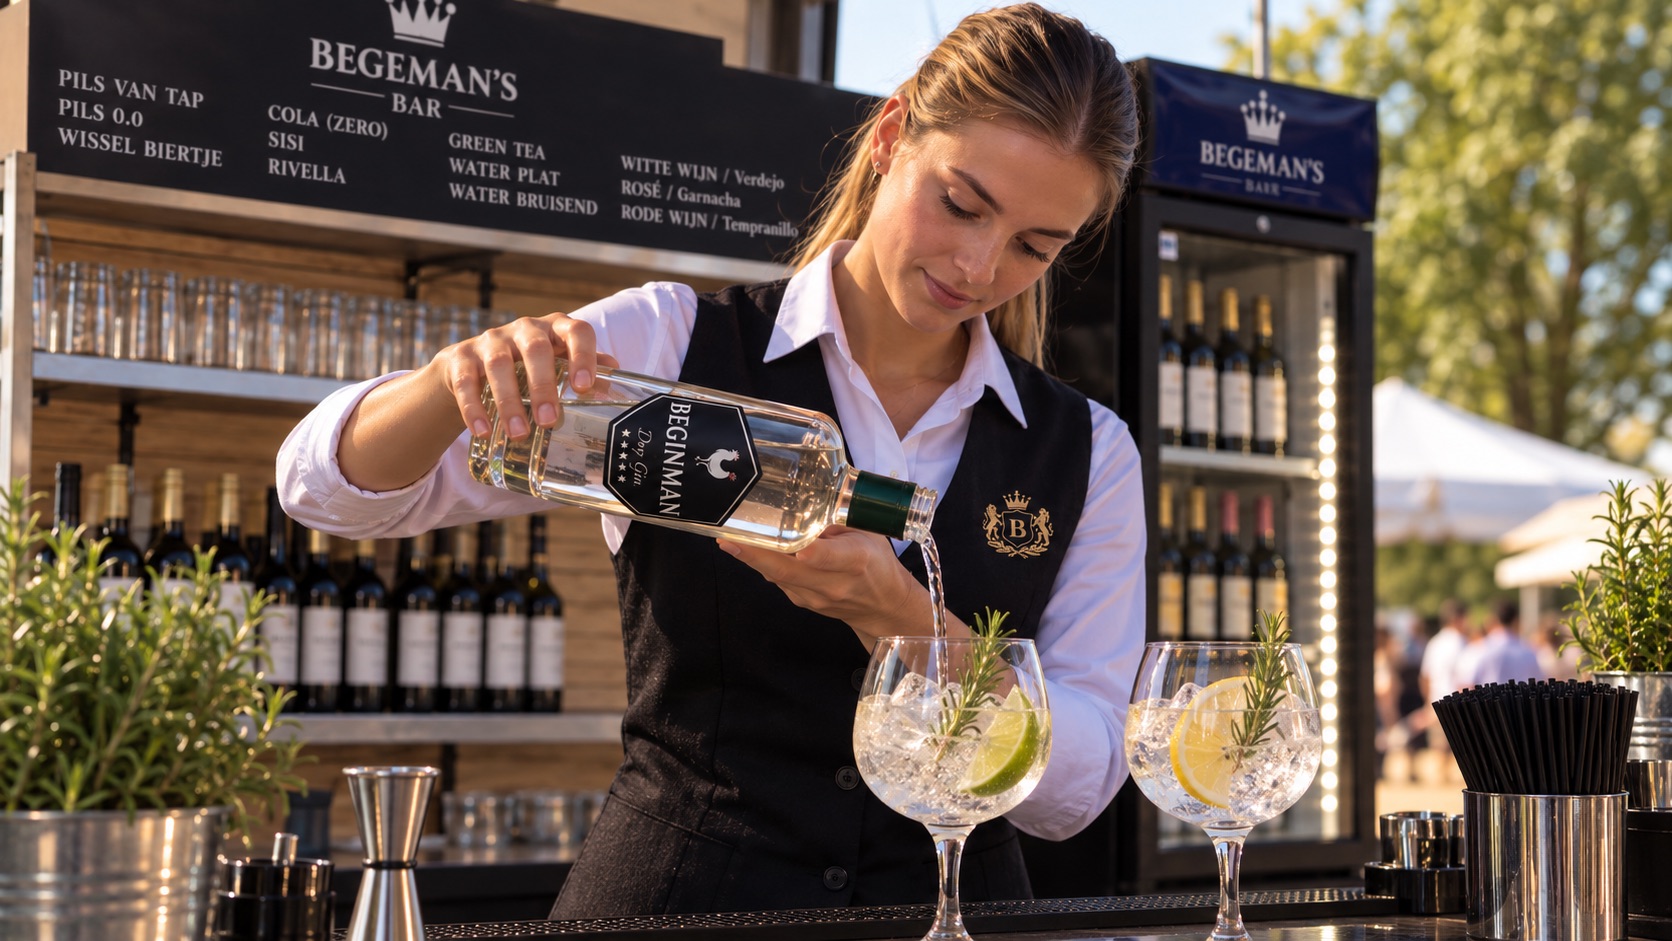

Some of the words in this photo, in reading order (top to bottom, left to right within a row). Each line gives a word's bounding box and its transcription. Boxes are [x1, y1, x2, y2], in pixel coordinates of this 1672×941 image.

[310, 37, 518, 102] BEGEMAN'S
[59, 69, 104, 92] PILS
[114, 79, 156, 101] VAN
[165, 88, 203, 108] TAP
[59, 99, 104, 121] PILS
[113, 108, 143, 127] 0.0
[392, 93, 442, 119] BAR
[268, 105, 318, 127] COLA
[327, 115, 389, 141] (ZERO)
[58, 127, 136, 155] WISSEL
[145, 141, 222, 167] BIERTJE
[269, 132, 303, 151] SISI
[449, 133, 506, 154] GREEN
[513, 142, 545, 160] TEA
[269, 158, 345, 183] RIVELLA
[450, 158, 510, 180] WATER
[518, 167, 560, 186] PLAT
[621, 156, 671, 175] WITTE
[678, 163, 717, 181] WIJN
[735, 170, 784, 192] Verdejo
[1200, 140, 1325, 184] BEGEMAN'S
[450, 183, 509, 204] WATER
[517, 192, 598, 214] BRUISEND
[622, 180, 661, 198] ROSÉ
[677, 186, 742, 208] Garnacha
[622, 205, 662, 223] RODE
[669, 210, 707, 228] WIJN
[724, 218, 799, 239] Tempranillo
[659, 402, 692, 516] BEGINMAN
[1009, 519, 1026, 537] B
